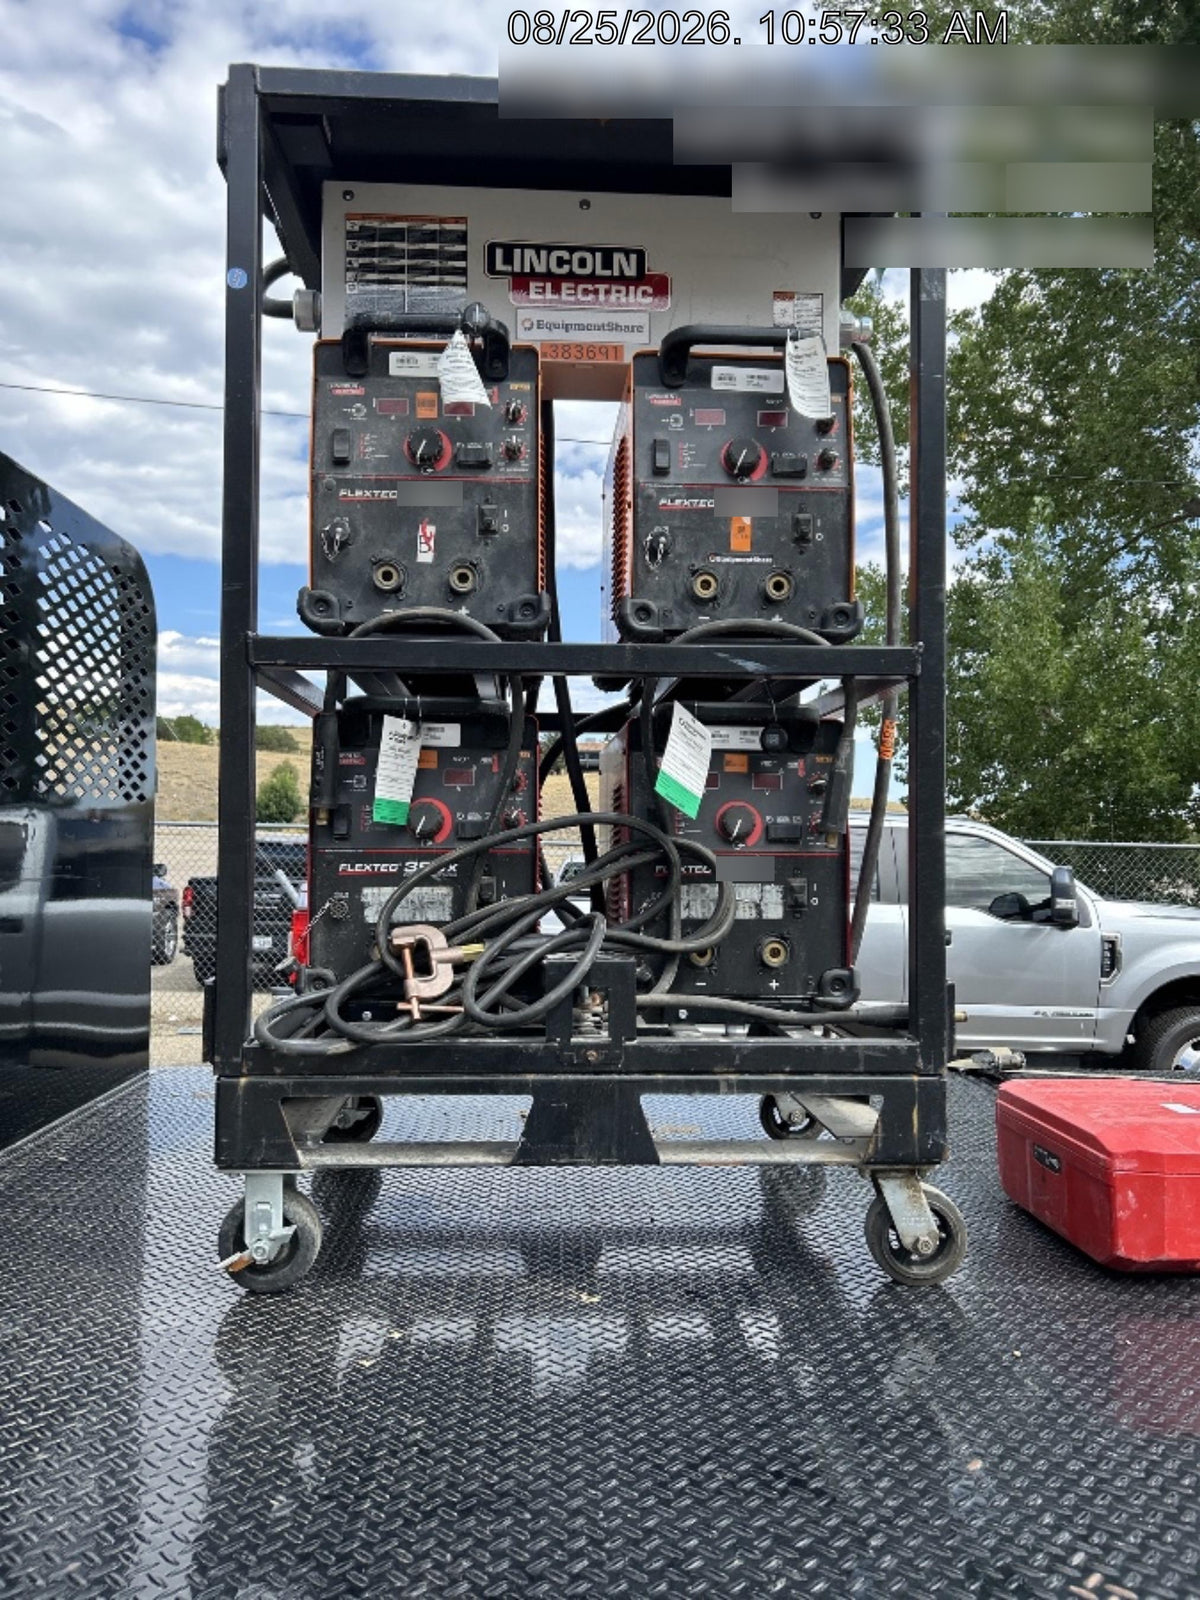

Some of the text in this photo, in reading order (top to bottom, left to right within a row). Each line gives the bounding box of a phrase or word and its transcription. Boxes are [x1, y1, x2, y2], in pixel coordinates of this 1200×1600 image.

[495, 247, 638, 277] LINCOLN
[528, 280, 654, 303] ELECTRIC
[536, 319, 645, 334] EquipmentShare
[548, 343, 618, 361] 383691
[339, 488, 398, 499] FLEXTEC
[658, 498, 714, 508] FLEXTEC
[339, 863, 399, 872] FLEXTEC
[655, 865, 712, 874] FLXTEC
